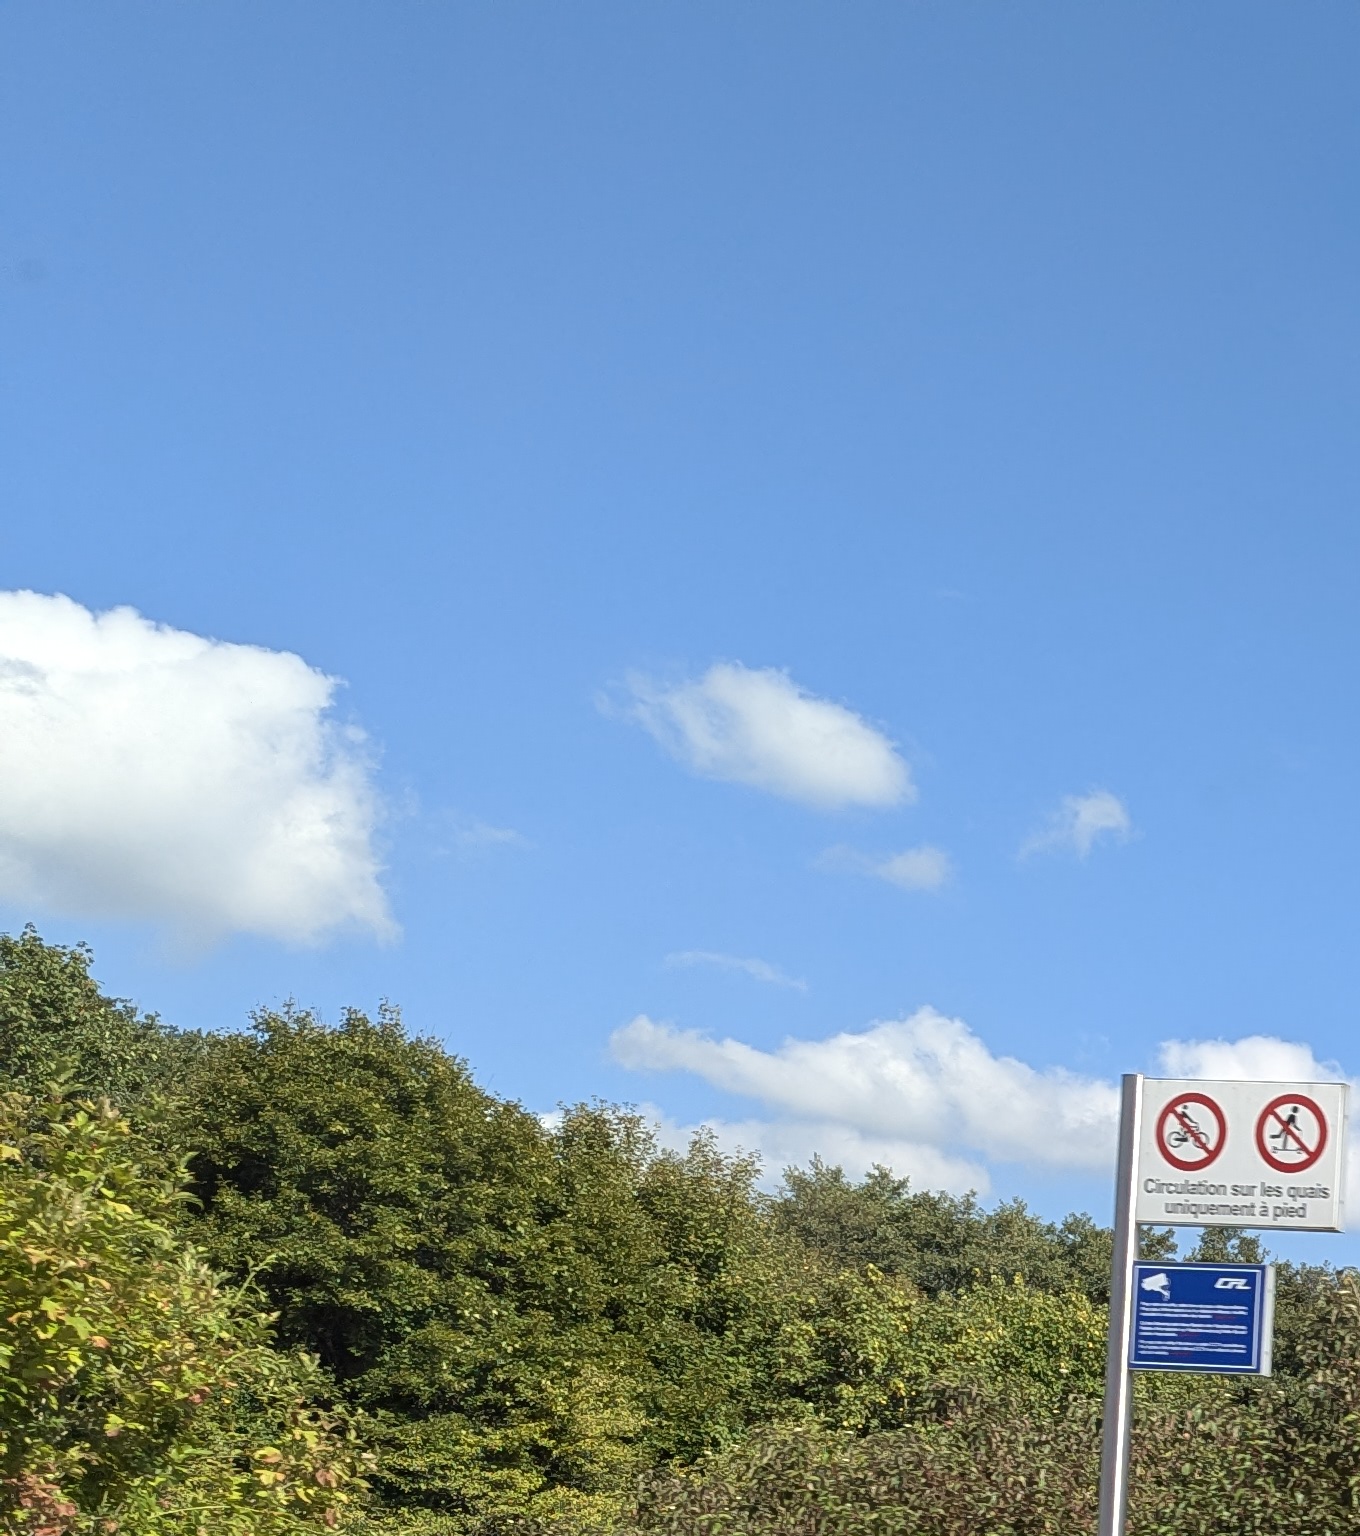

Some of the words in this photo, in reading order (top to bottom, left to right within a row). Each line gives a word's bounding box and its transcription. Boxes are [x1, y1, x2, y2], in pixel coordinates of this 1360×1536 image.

[1143, 1178, 1228, 1197] Circulation
[1231, 1183, 1257, 1198] sur
[1260, 1181, 1283, 1199] les
[1287, 1182, 1330, 1202] quais
[1164, 1200, 1256, 1219] uniquement
[1258, 1201, 1270, 1217] à
[1272, 1202, 1307, 1222] pied
